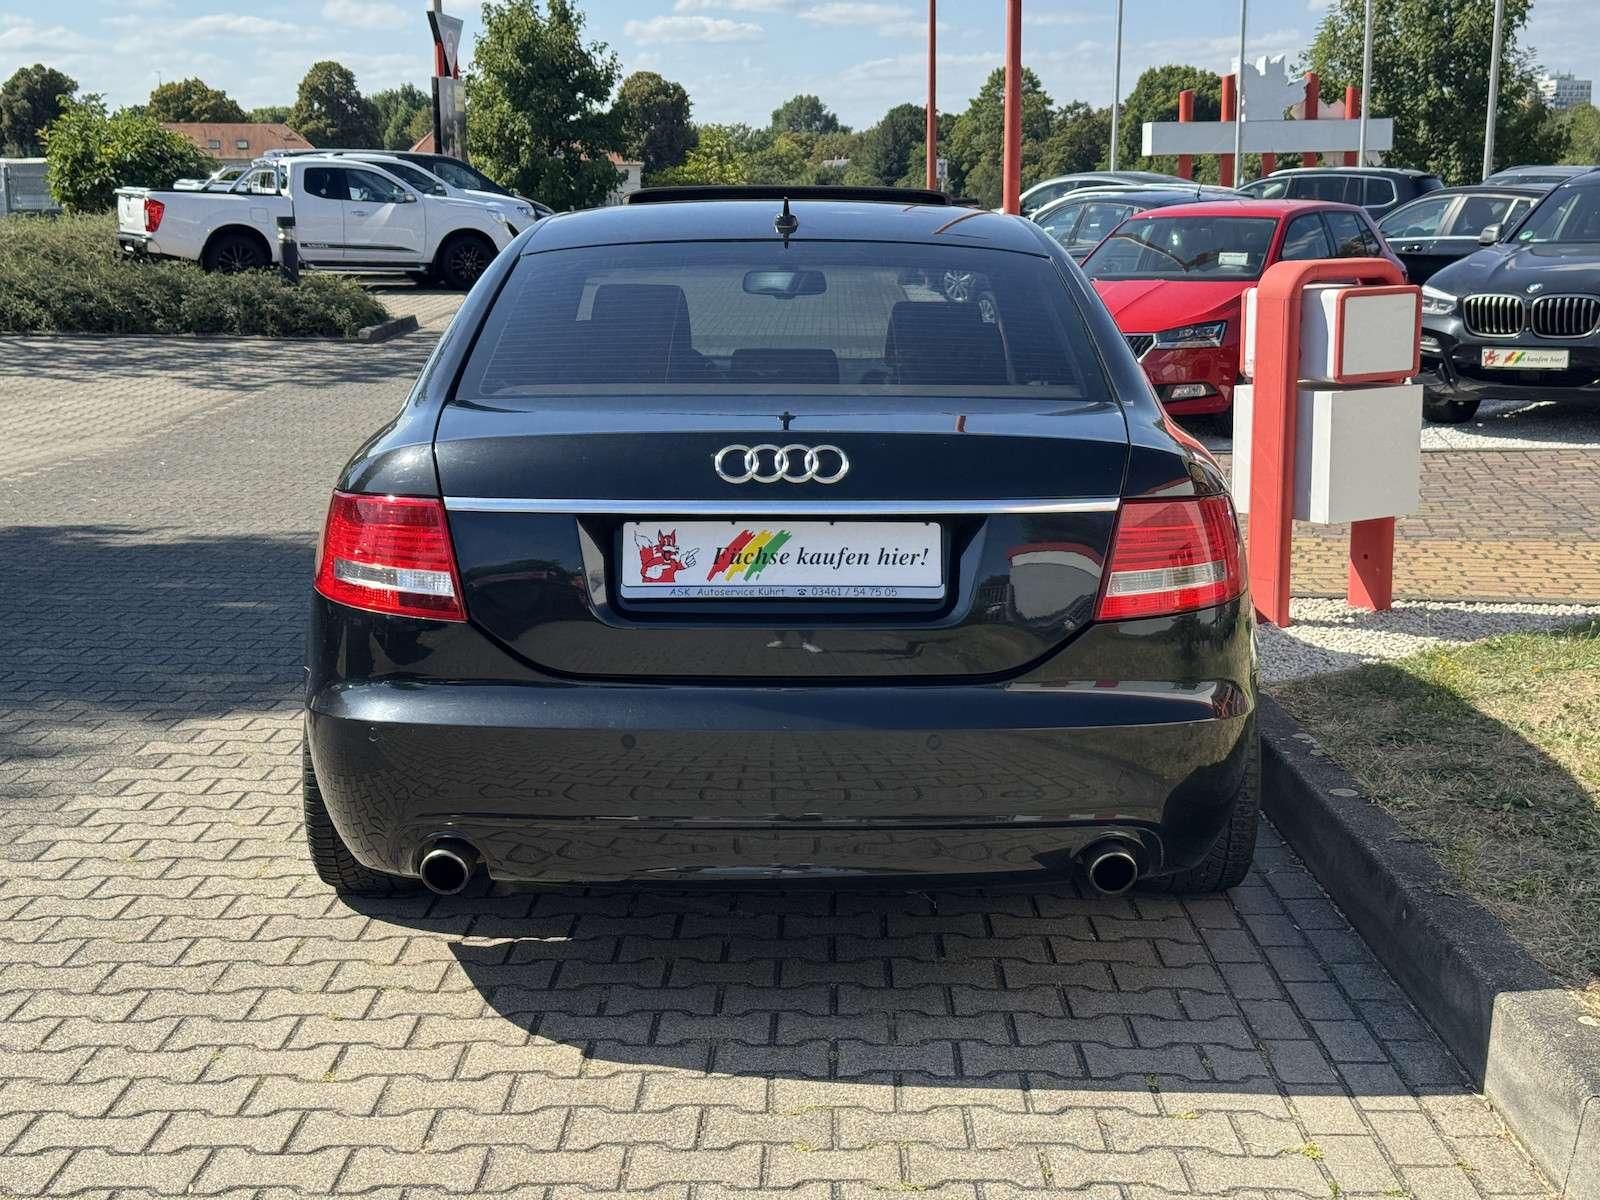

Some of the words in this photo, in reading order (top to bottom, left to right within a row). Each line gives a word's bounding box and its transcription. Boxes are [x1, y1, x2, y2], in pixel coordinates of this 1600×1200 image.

[712, 546, 790, 566] Füchse
[796, 546, 870, 570] kaufen
[877, 546, 929, 566] hier!
[669, 587, 691, 597] ASK
[696, 587, 755, 597] Autoservice
[811, 587, 842, 597] 03461
[853, 587, 865, 597] 54
[869, 587, 881, 597] 75
[884, 587, 897, 597] 05
